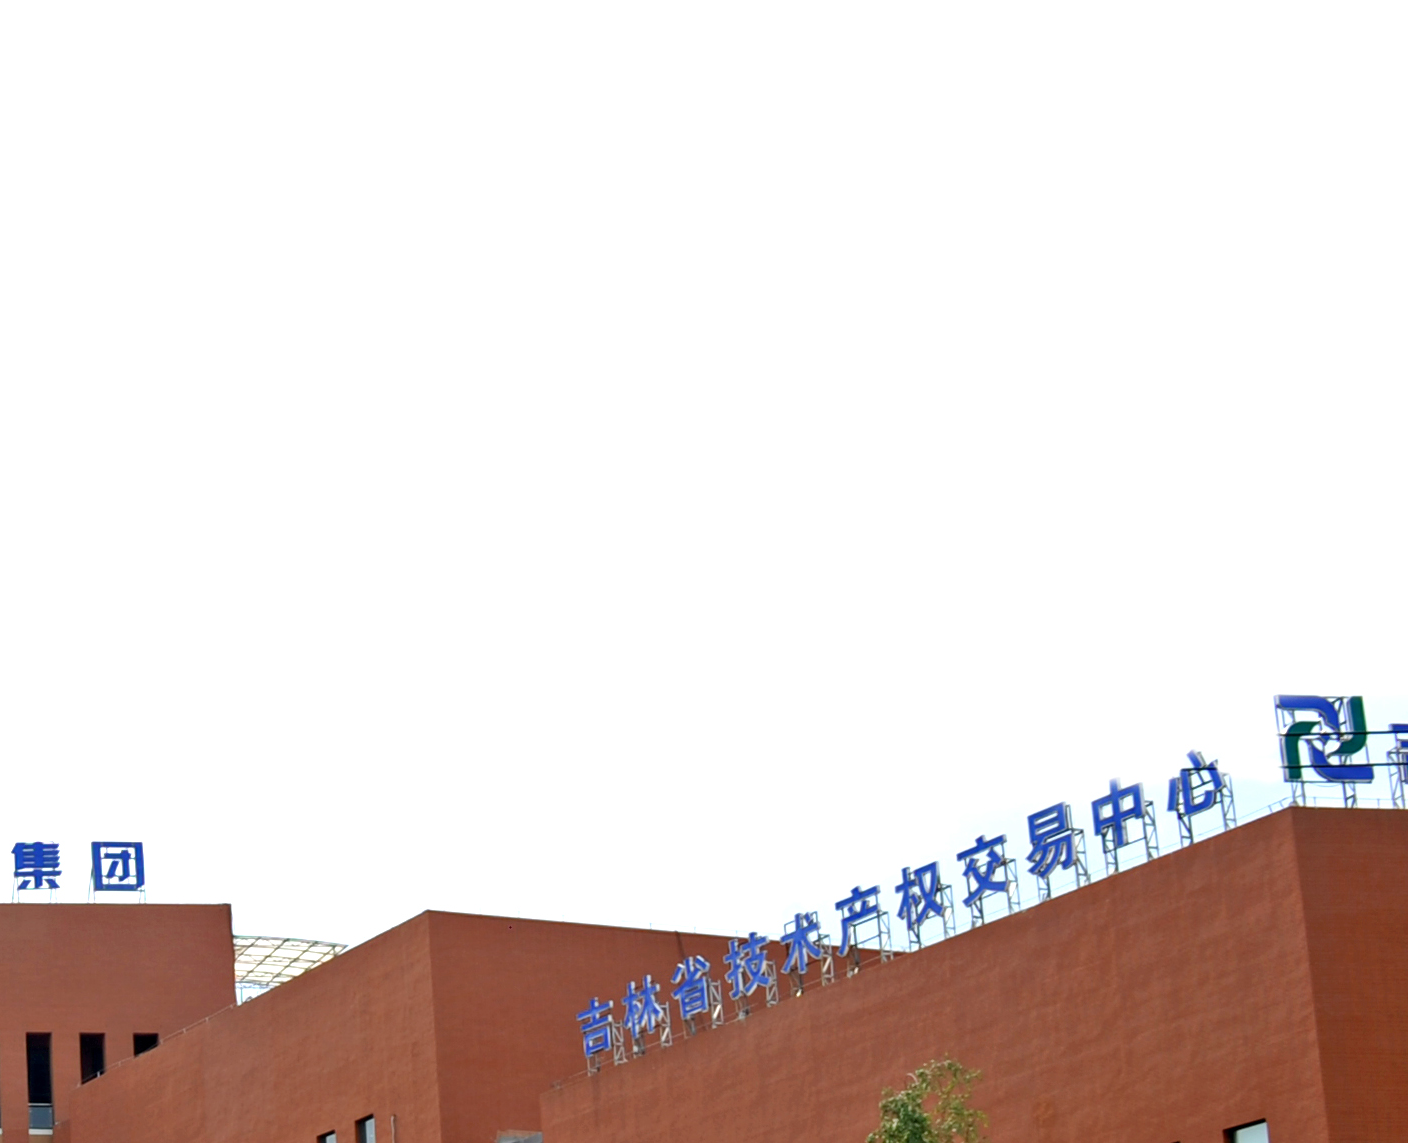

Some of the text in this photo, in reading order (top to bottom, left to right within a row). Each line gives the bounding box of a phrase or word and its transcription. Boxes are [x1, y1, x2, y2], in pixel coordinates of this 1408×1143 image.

[576, 750, 1221, 1059] 吉林省技术产权交易中心
